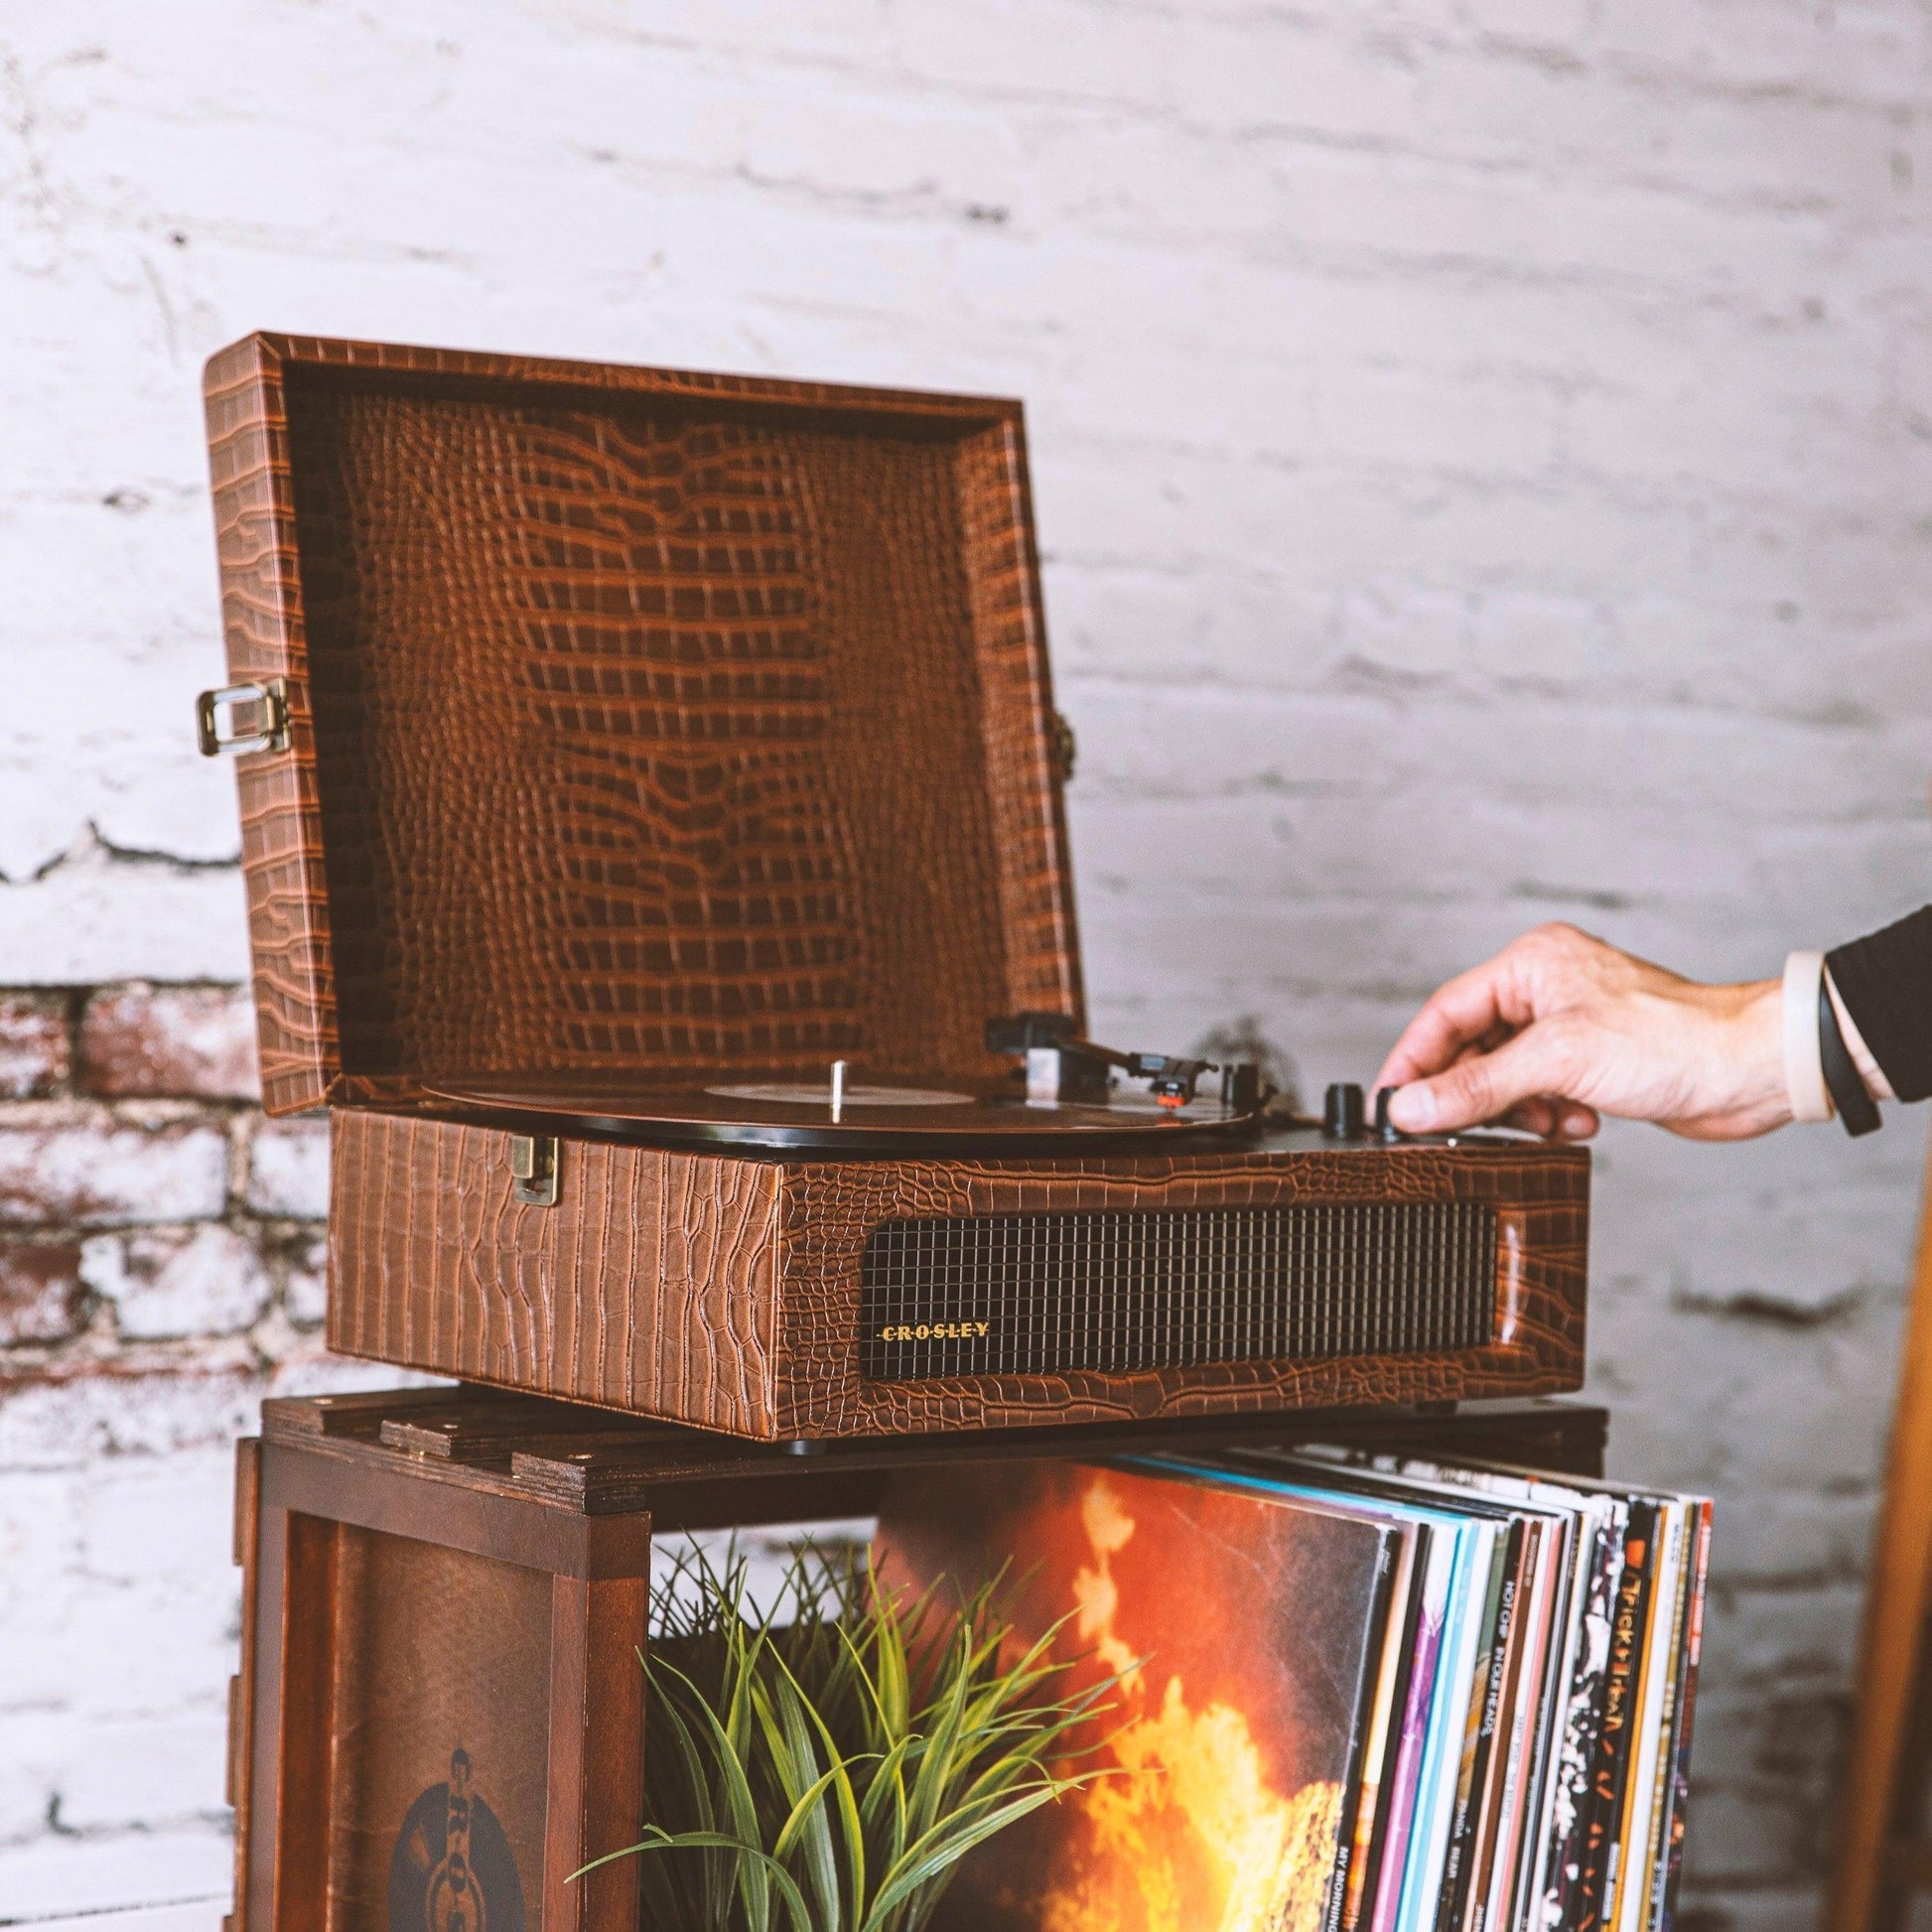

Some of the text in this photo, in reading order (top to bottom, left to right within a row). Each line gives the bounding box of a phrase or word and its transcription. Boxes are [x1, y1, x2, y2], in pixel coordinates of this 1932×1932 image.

[882, 1322, 989, 1341] CROSLEY
[1480, 1582, 1514, 1737] HOT CHIP IN OUR HEADS
[1336, 1846, 1349, 1867] MY
[1448, 1799, 1468, 1878] PANDA BEAR
